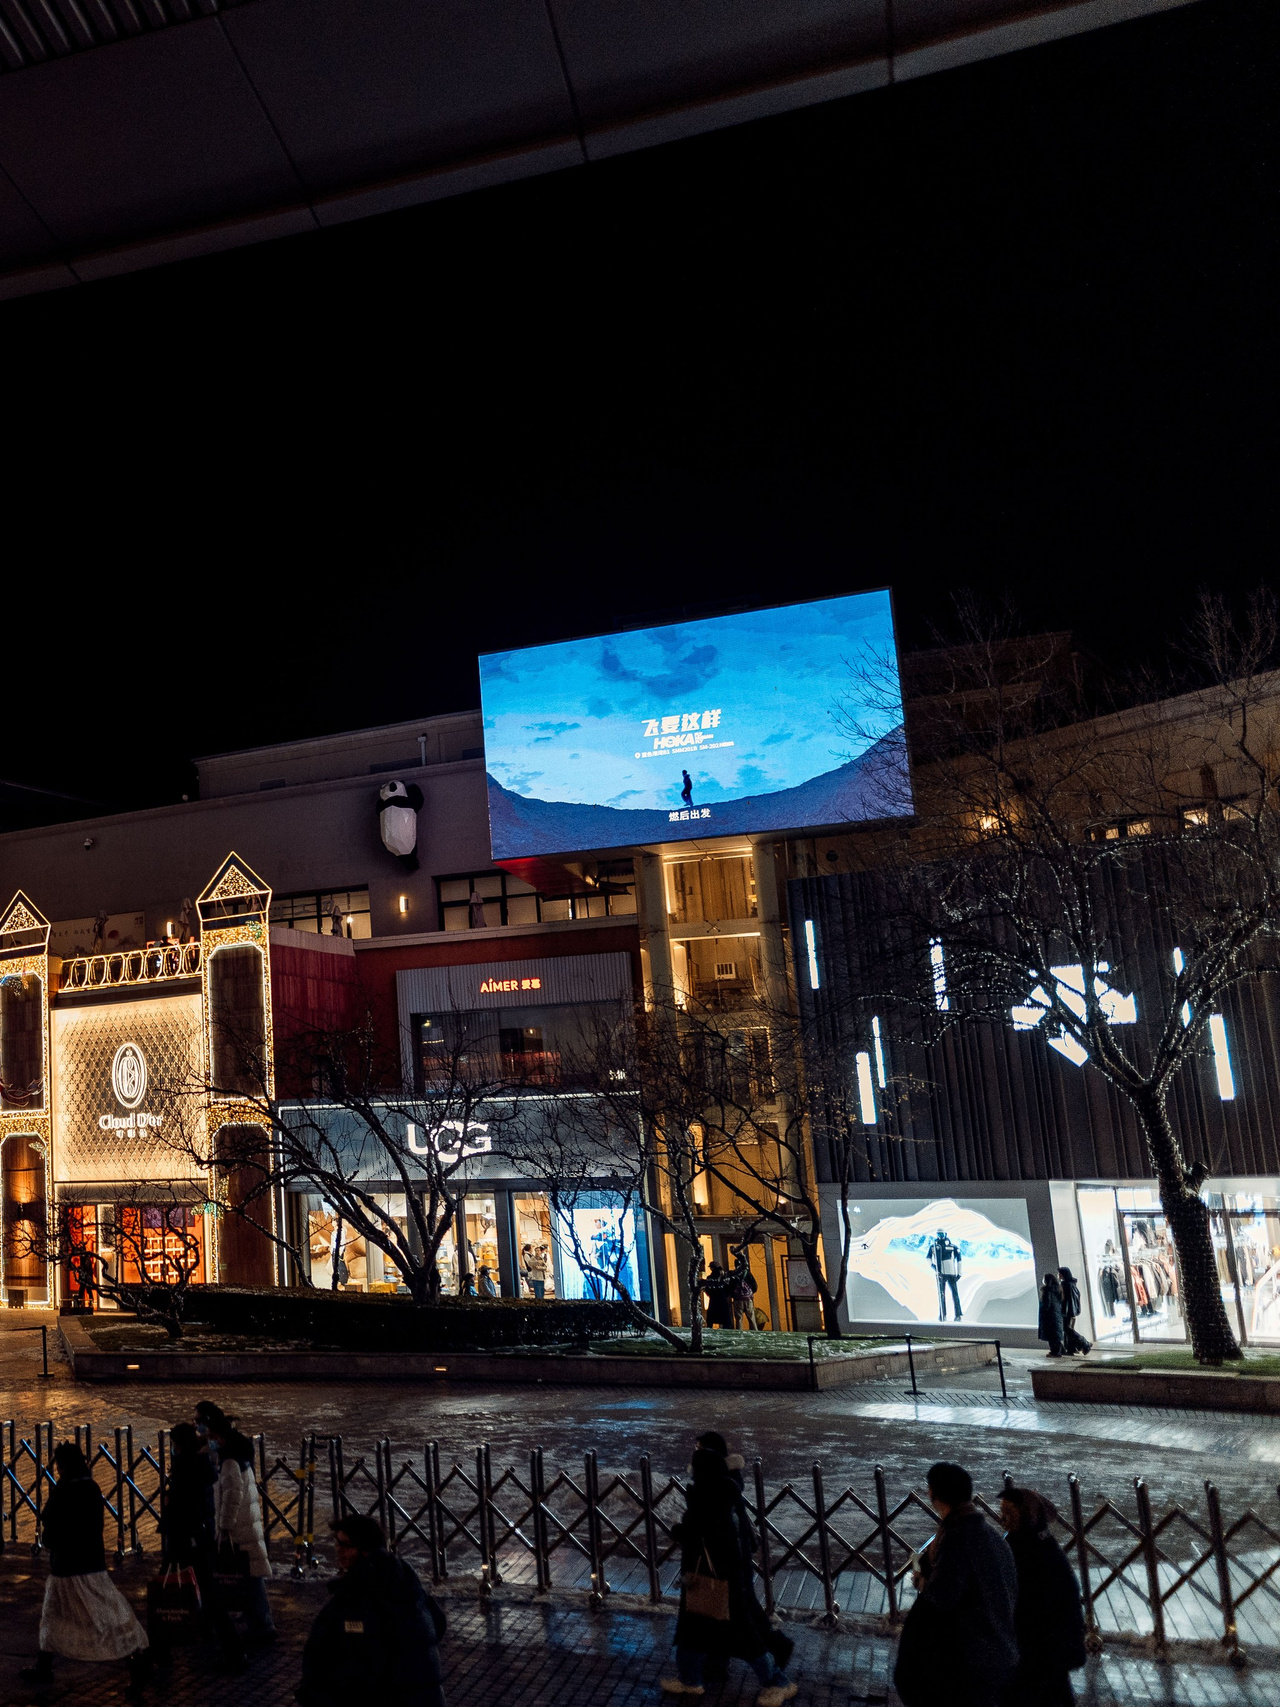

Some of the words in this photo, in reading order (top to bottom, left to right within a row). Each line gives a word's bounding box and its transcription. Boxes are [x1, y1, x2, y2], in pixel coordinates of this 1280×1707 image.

[641, 709, 721, 737] 飞要这样
[653, 733, 695, 750] HOKA
[668, 808, 711, 822] 燃后出发
[99, 1113, 135, 1129] Cloud
